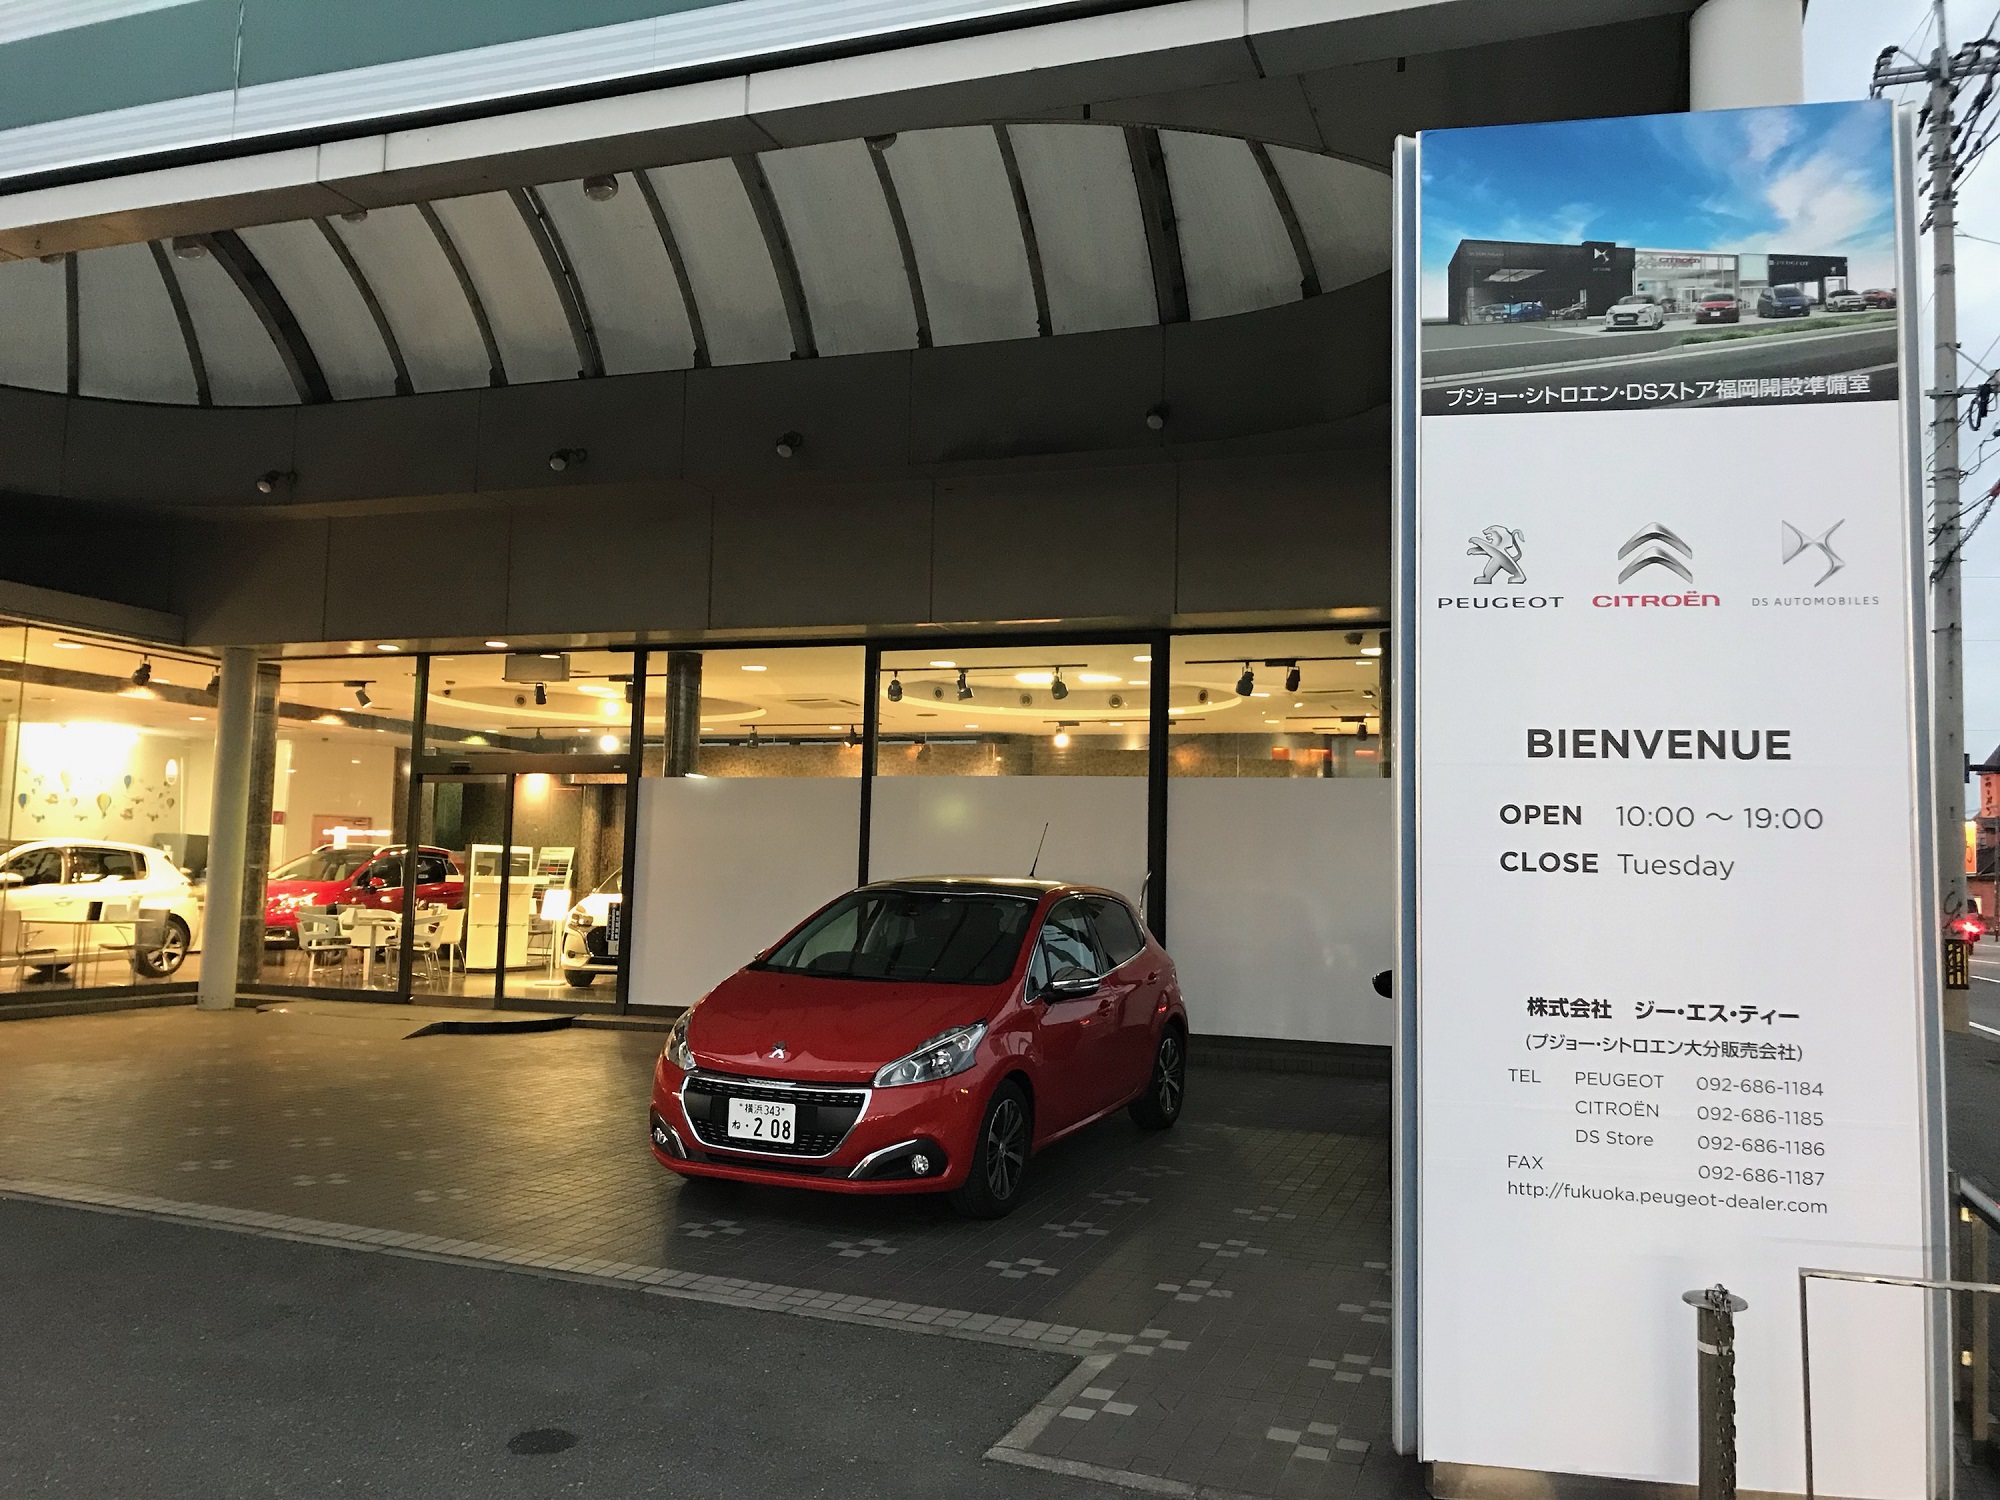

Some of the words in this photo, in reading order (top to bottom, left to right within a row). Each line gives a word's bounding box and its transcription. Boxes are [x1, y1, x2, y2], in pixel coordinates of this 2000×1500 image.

[1445, 375, 1871, 407] プジョー・シトロエン・DSストア福岡開設準備室
[1437, 596, 1565, 609] PEUGEOT
[1751, 597, 1769, 607] DS
[1773, 595, 1880, 607] AUTOMOBILES
[1526, 728, 1792, 761] BIENVENUE
[1499, 804, 1583, 826] OPEN
[1615, 805, 1695, 828] 10:00
[1743, 807, 1824, 830] 19:00
[1499, 850, 1599, 874] CLOSE
[1616, 853, 1736, 881] Tuesday
[1526, 996, 1613, 1020] 株式会社
[1507, 1068, 1542, 1084] TEL
[1575, 1071, 1665, 1089] PEUGEOT
[1695, 1076, 1825, 1097] 092-686-1184
[1575, 1100, 1660, 1118] CITROËN
[1696, 1106, 1824, 1127] 092-686-1185
[1575, 1129, 1600, 1144] DS
[1606, 1131, 1654, 1147] Store
[1697, 1136, 1826, 1157] 092-686-1186
[1507, 1155, 1544, 1171] FAX
[1697, 1165, 1825, 1187] 092-686-1187
[1507, 1181, 1828, 1214] http://fukuoka.peugeot-dealer.com
